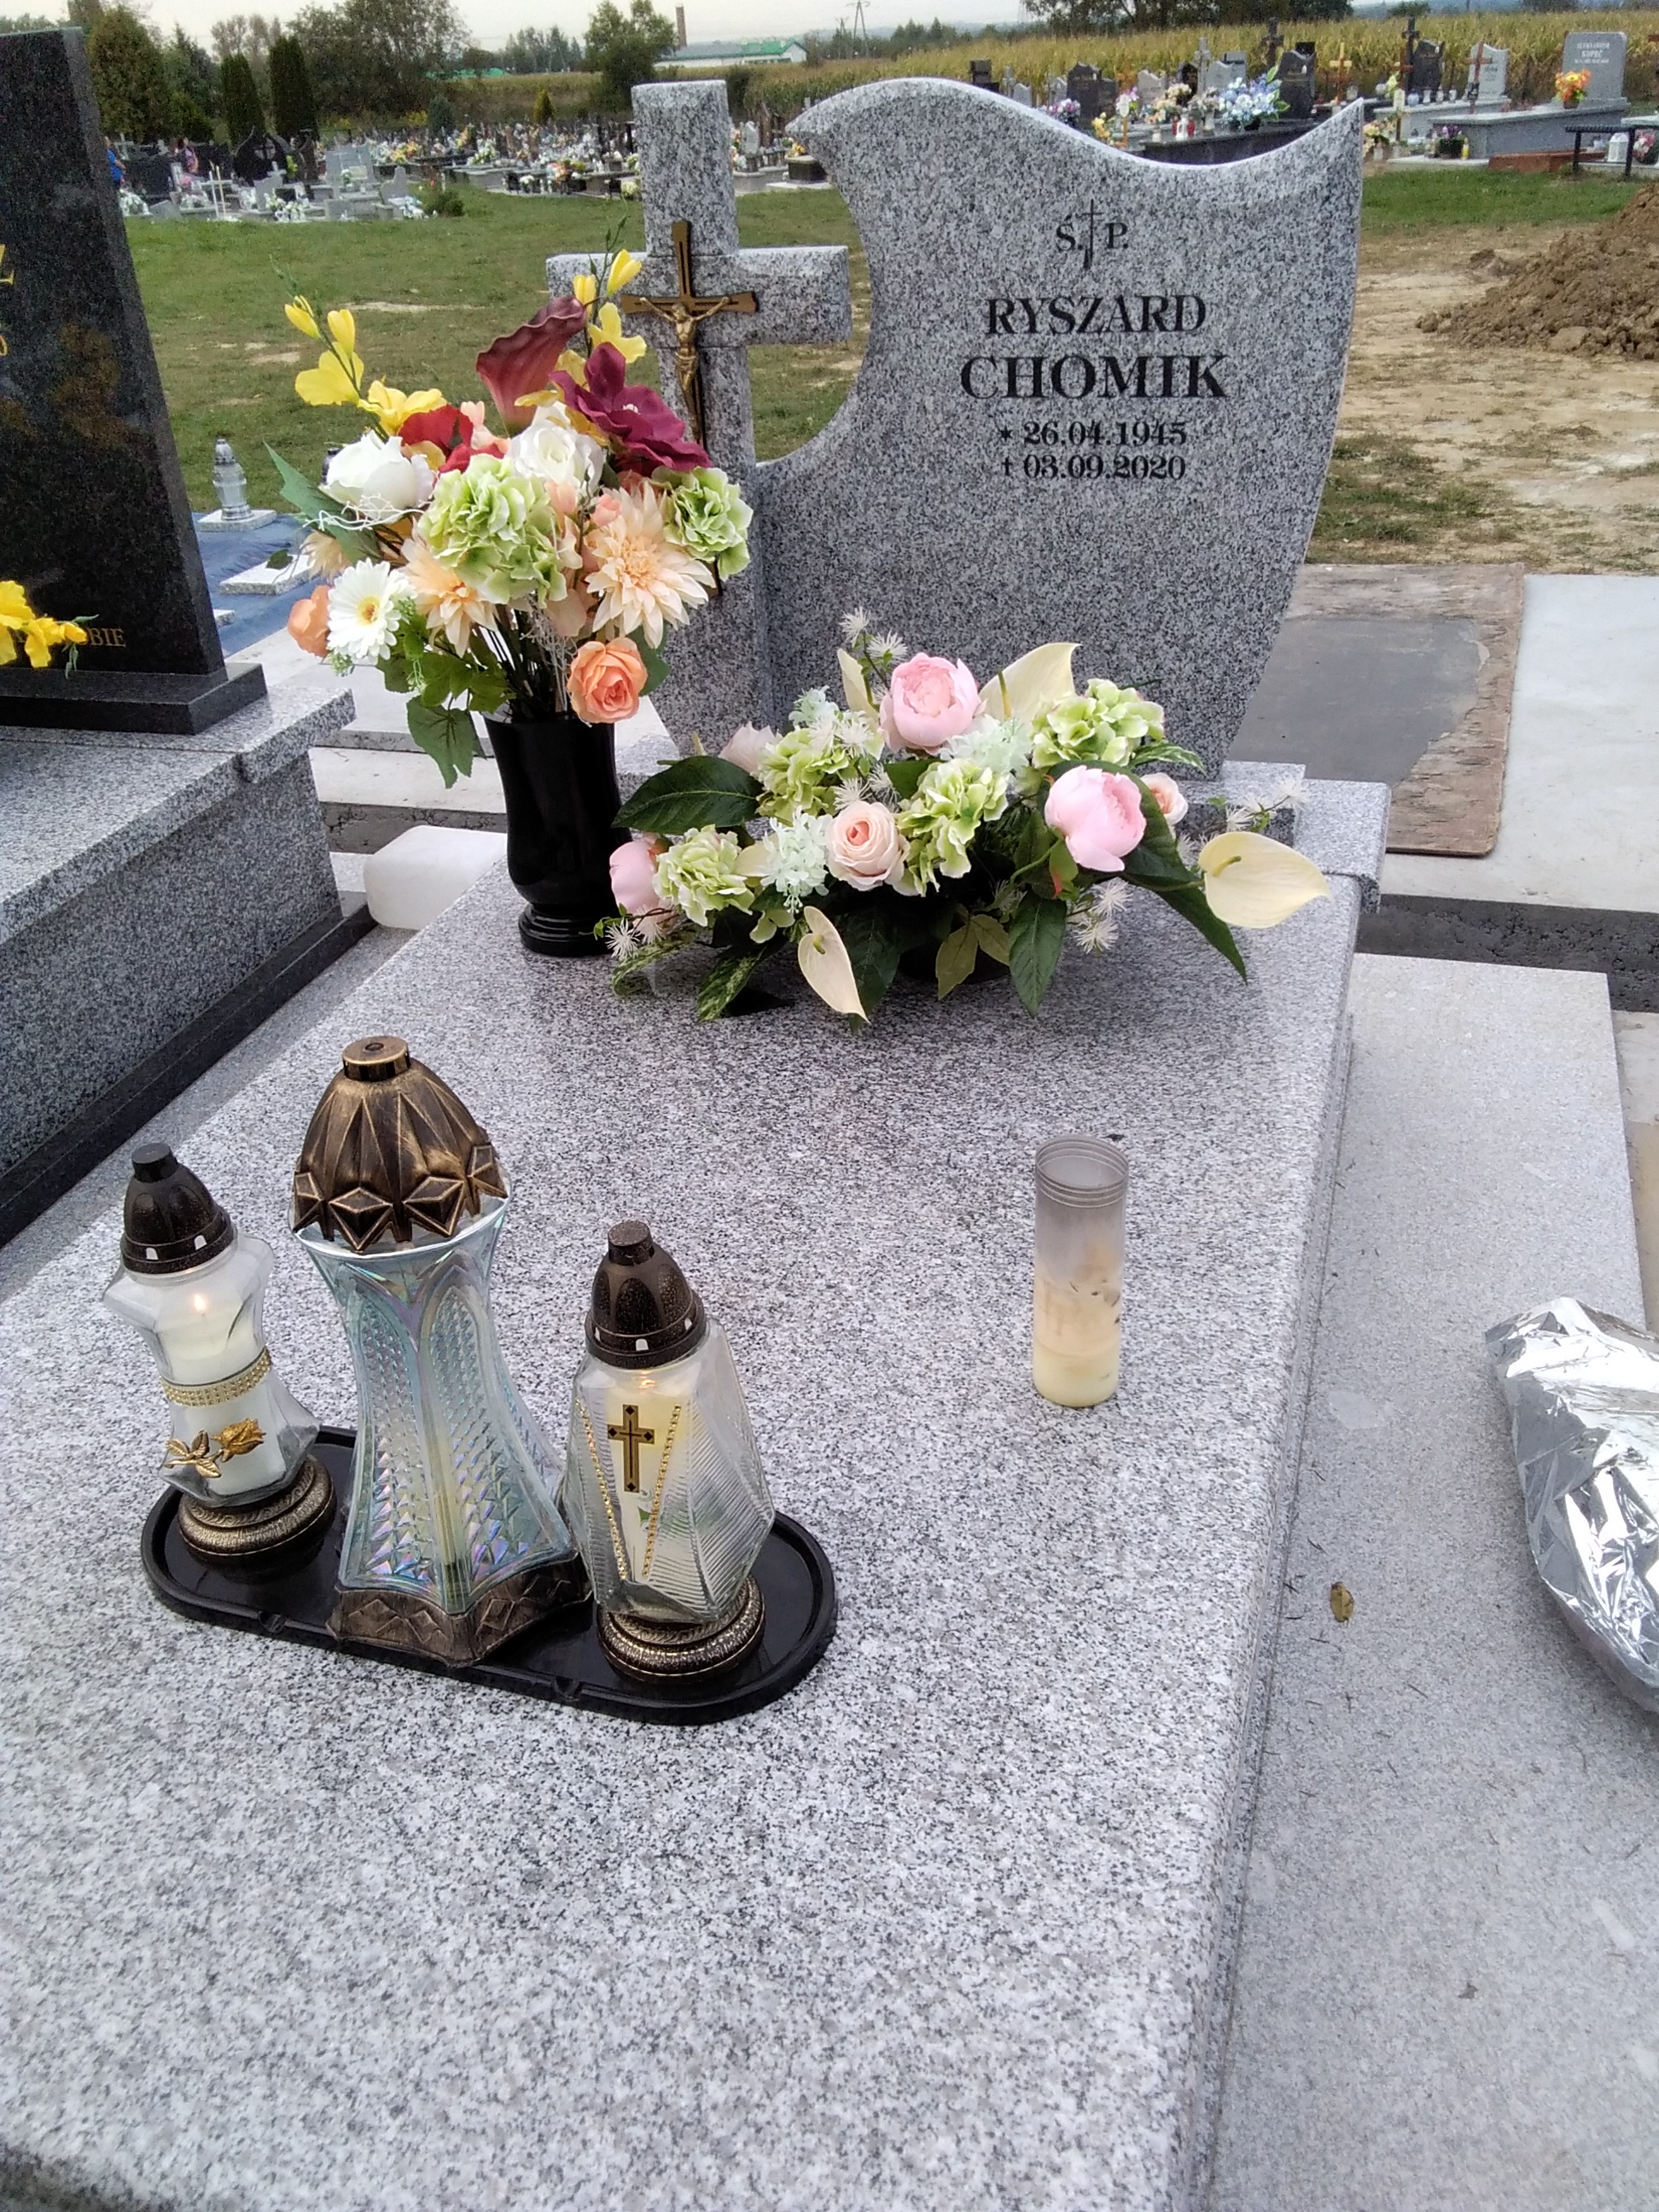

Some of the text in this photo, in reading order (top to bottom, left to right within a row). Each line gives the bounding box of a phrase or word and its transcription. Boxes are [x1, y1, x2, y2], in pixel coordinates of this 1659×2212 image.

[987, 295, 1206, 335] RYSZARD
[961, 354, 1230, 399] CHOMIK
[1024, 420, 1187, 446] 26.04.1945
[1024, 454, 1186, 480] 03.09.2020
